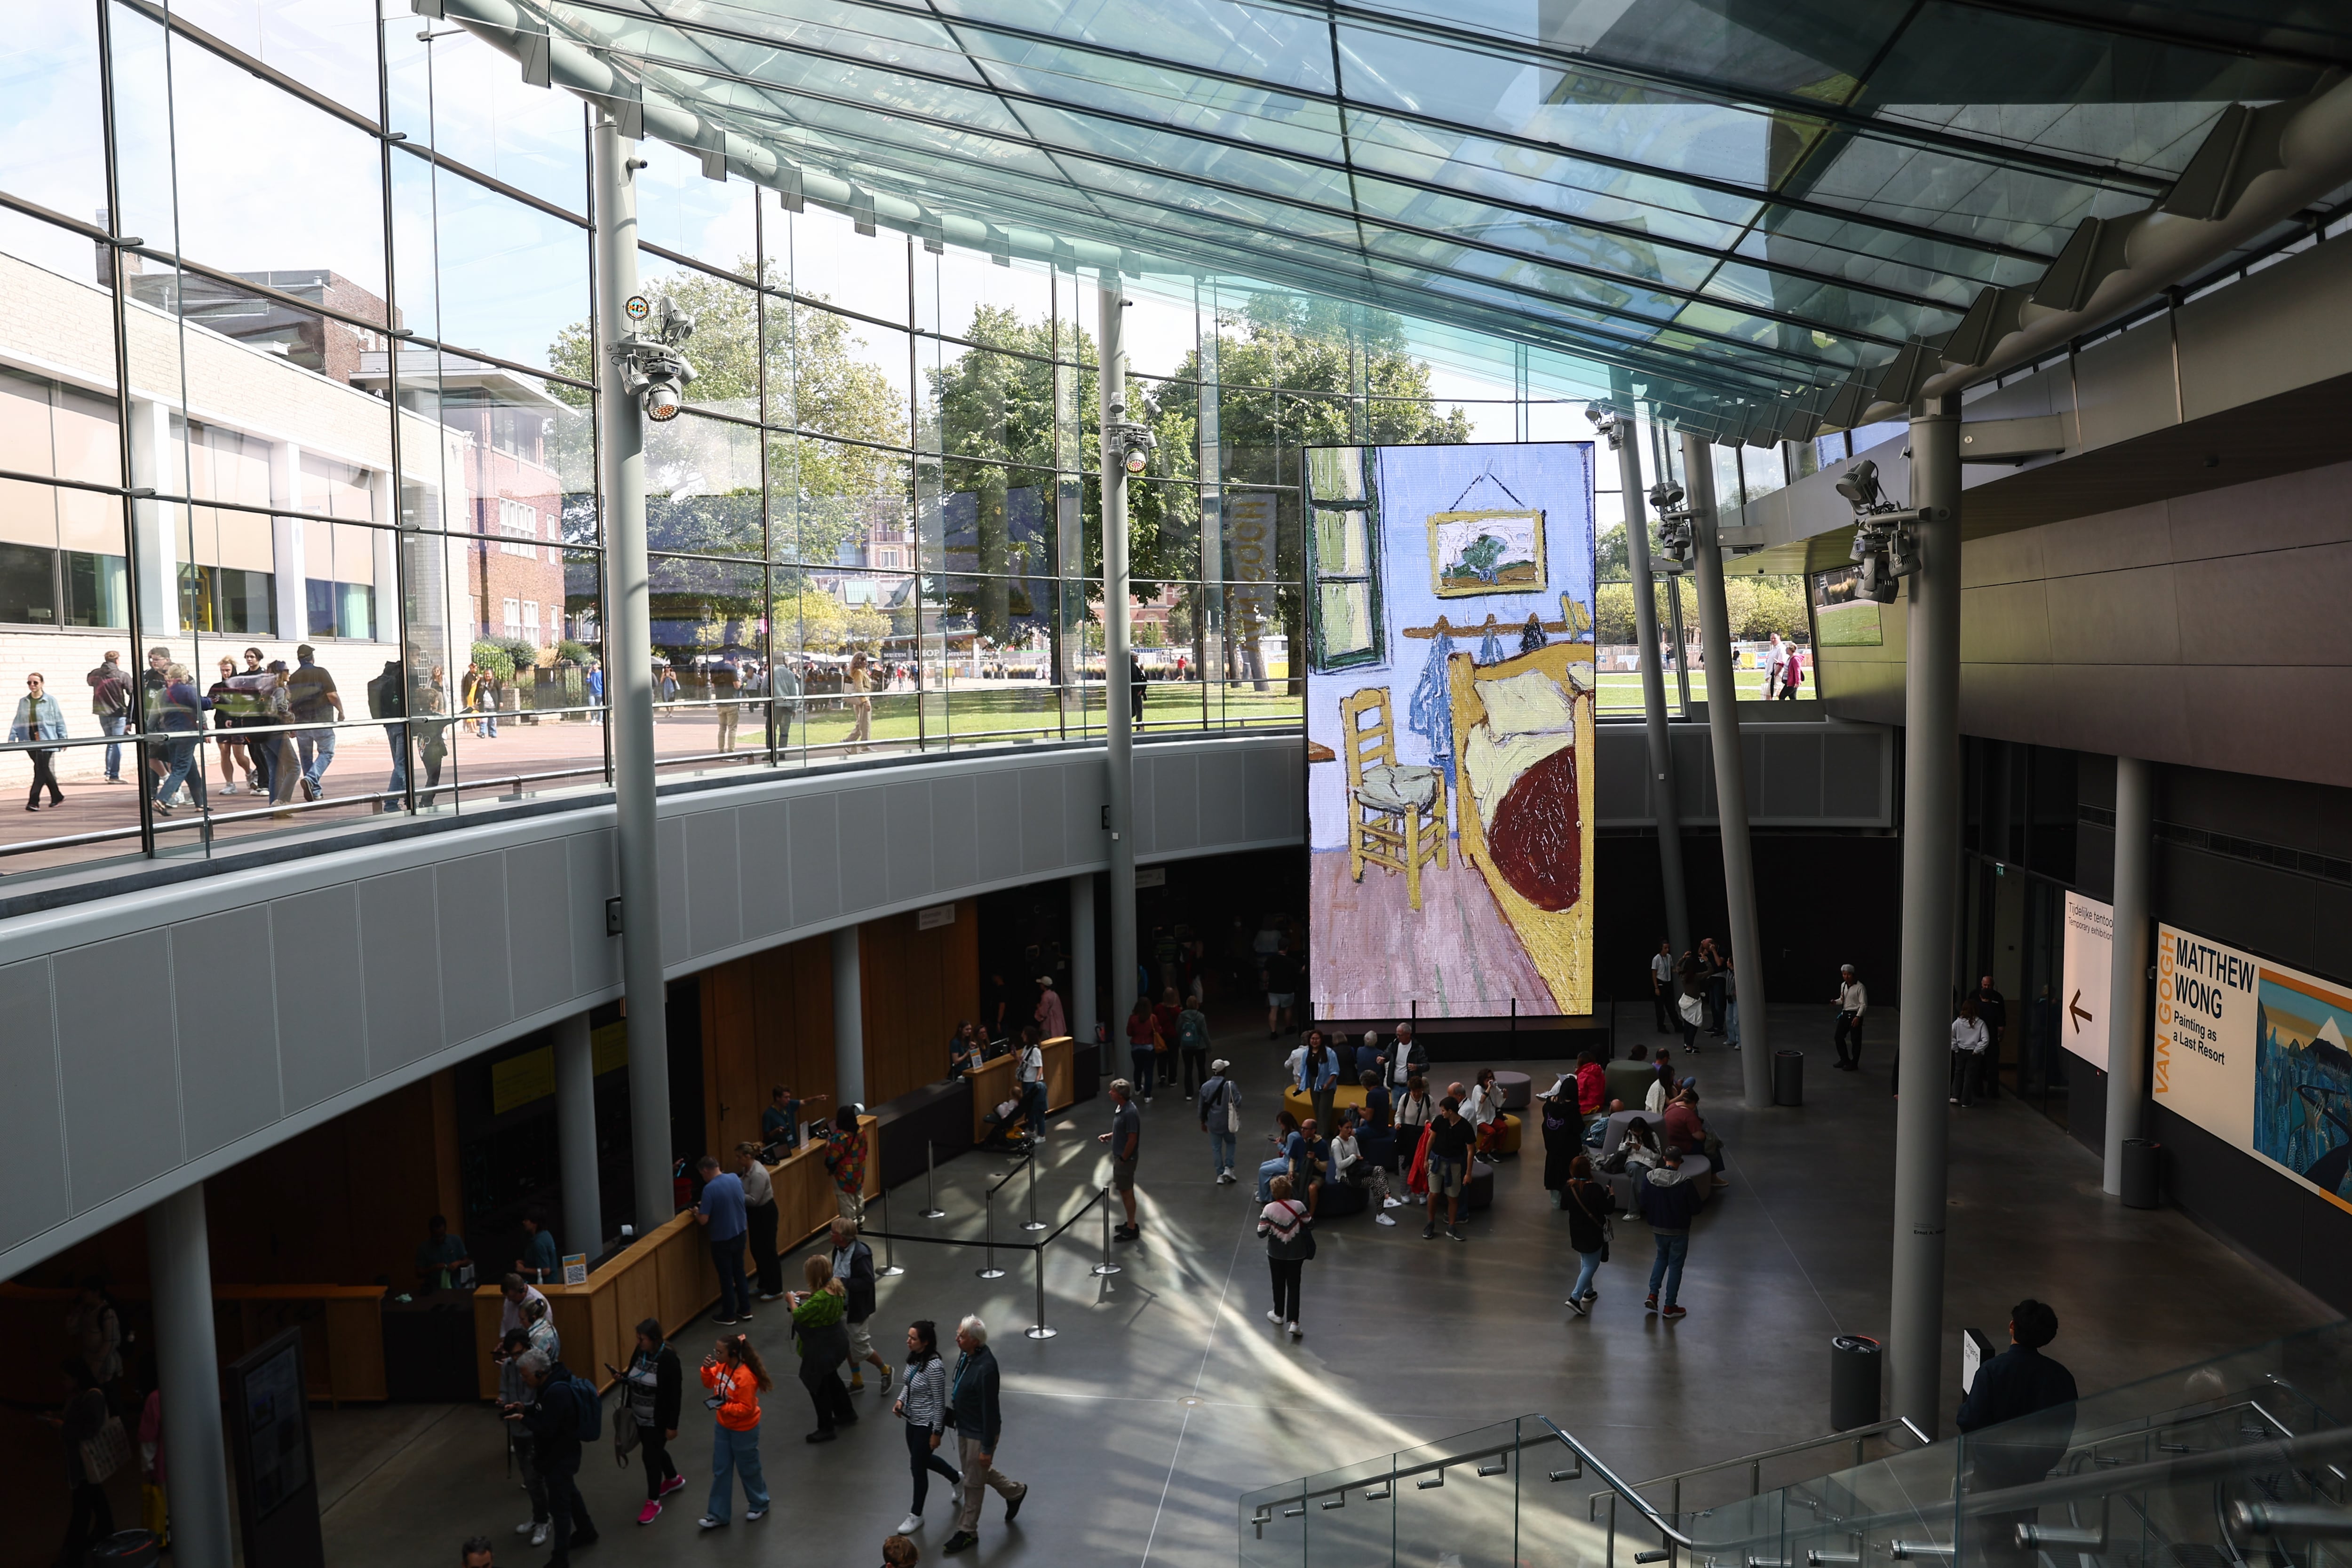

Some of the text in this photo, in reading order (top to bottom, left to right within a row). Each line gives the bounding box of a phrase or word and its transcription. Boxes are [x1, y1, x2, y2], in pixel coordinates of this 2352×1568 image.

[2068, 916, 2112, 941] Temporary exhibition
[2069, 902, 2113, 927] Tijdelijke tentoo
[2177, 937, 2255, 994] MATTHEW
[2155, 931, 2174, 1093] VAN GOGH
[2175, 972, 2222, 1019] WONG
[2174, 1010, 2217, 1042] Painting as
[2173, 1031, 2225, 1065] a Last Resort
